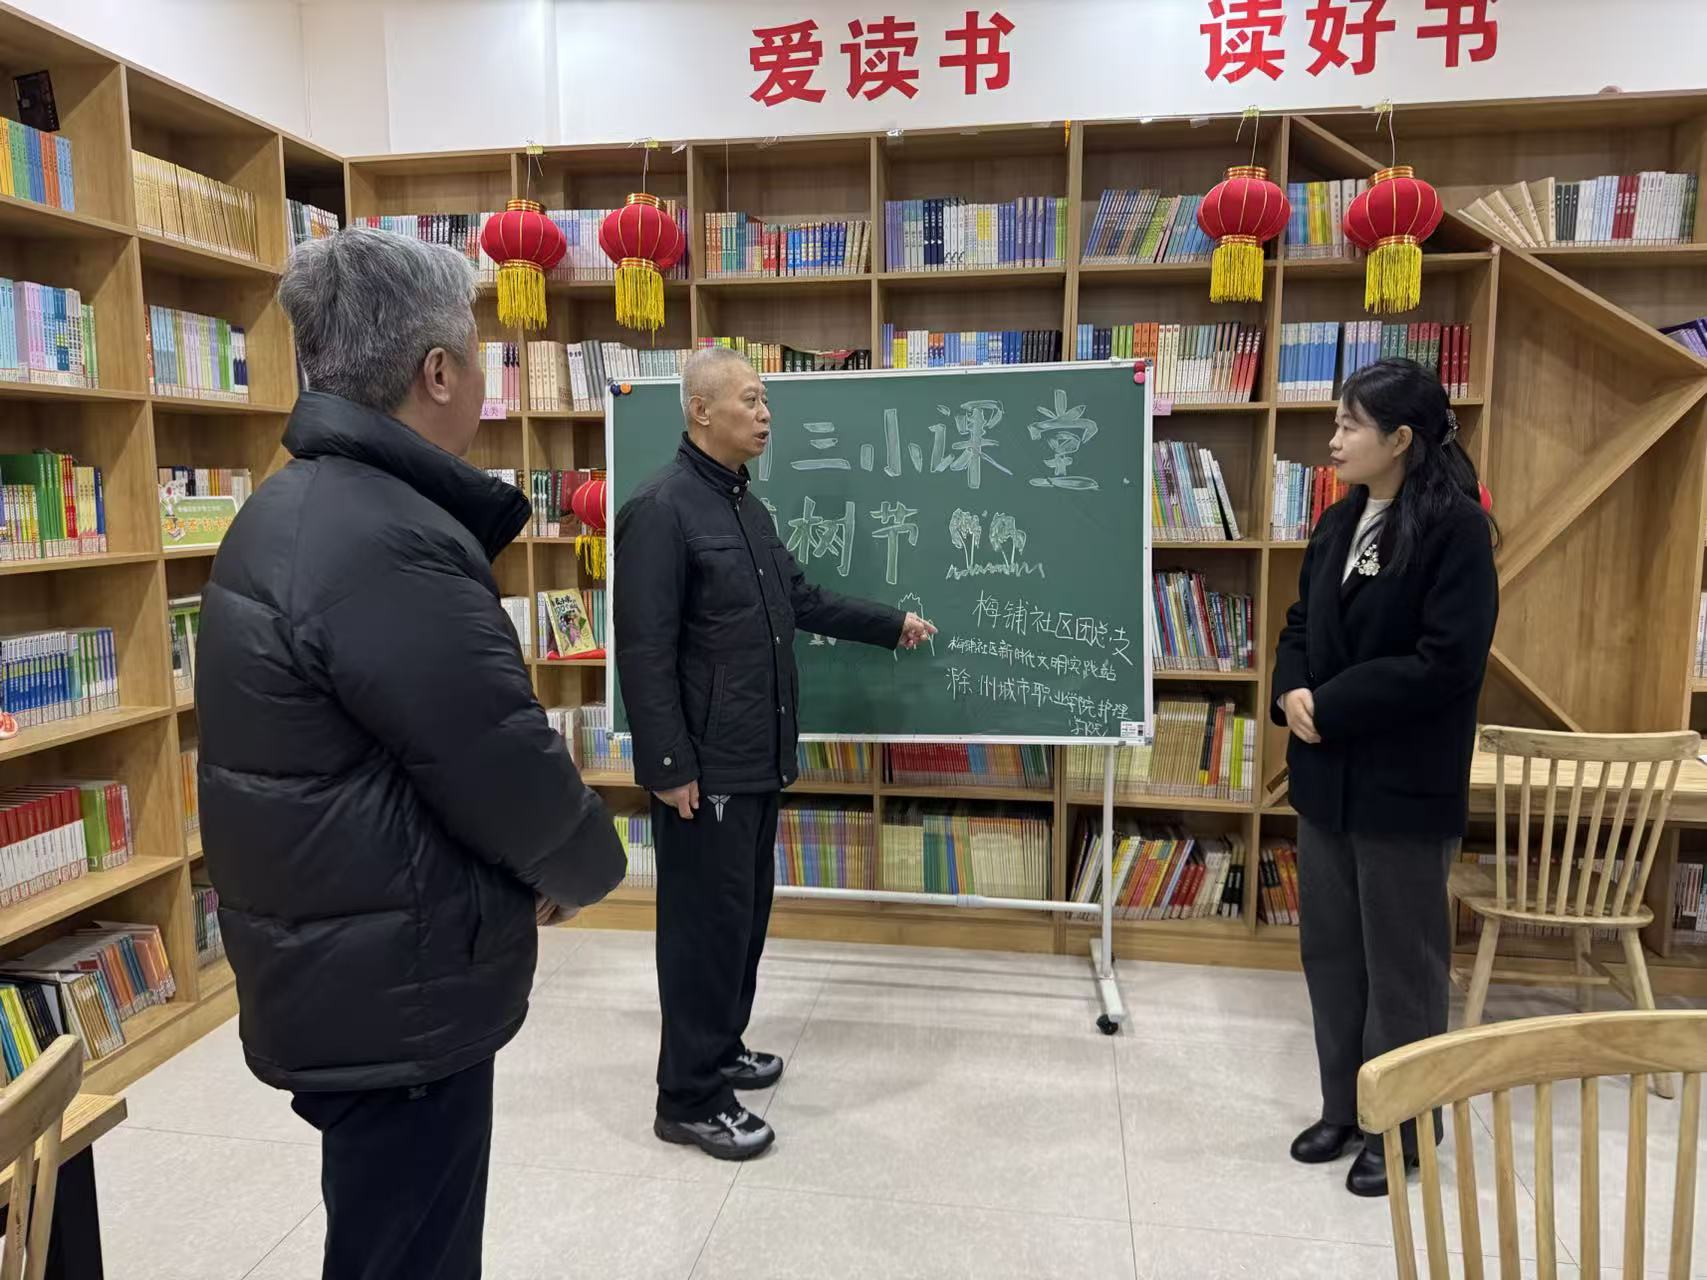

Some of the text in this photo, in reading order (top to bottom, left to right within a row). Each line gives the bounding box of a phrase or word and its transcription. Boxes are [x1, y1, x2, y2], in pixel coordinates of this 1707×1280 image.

[750, 0, 1498, 107] 爱读书 读好书
[759, 390, 1099, 490] 三小课堂
[761, 496, 918, 585] 树节
